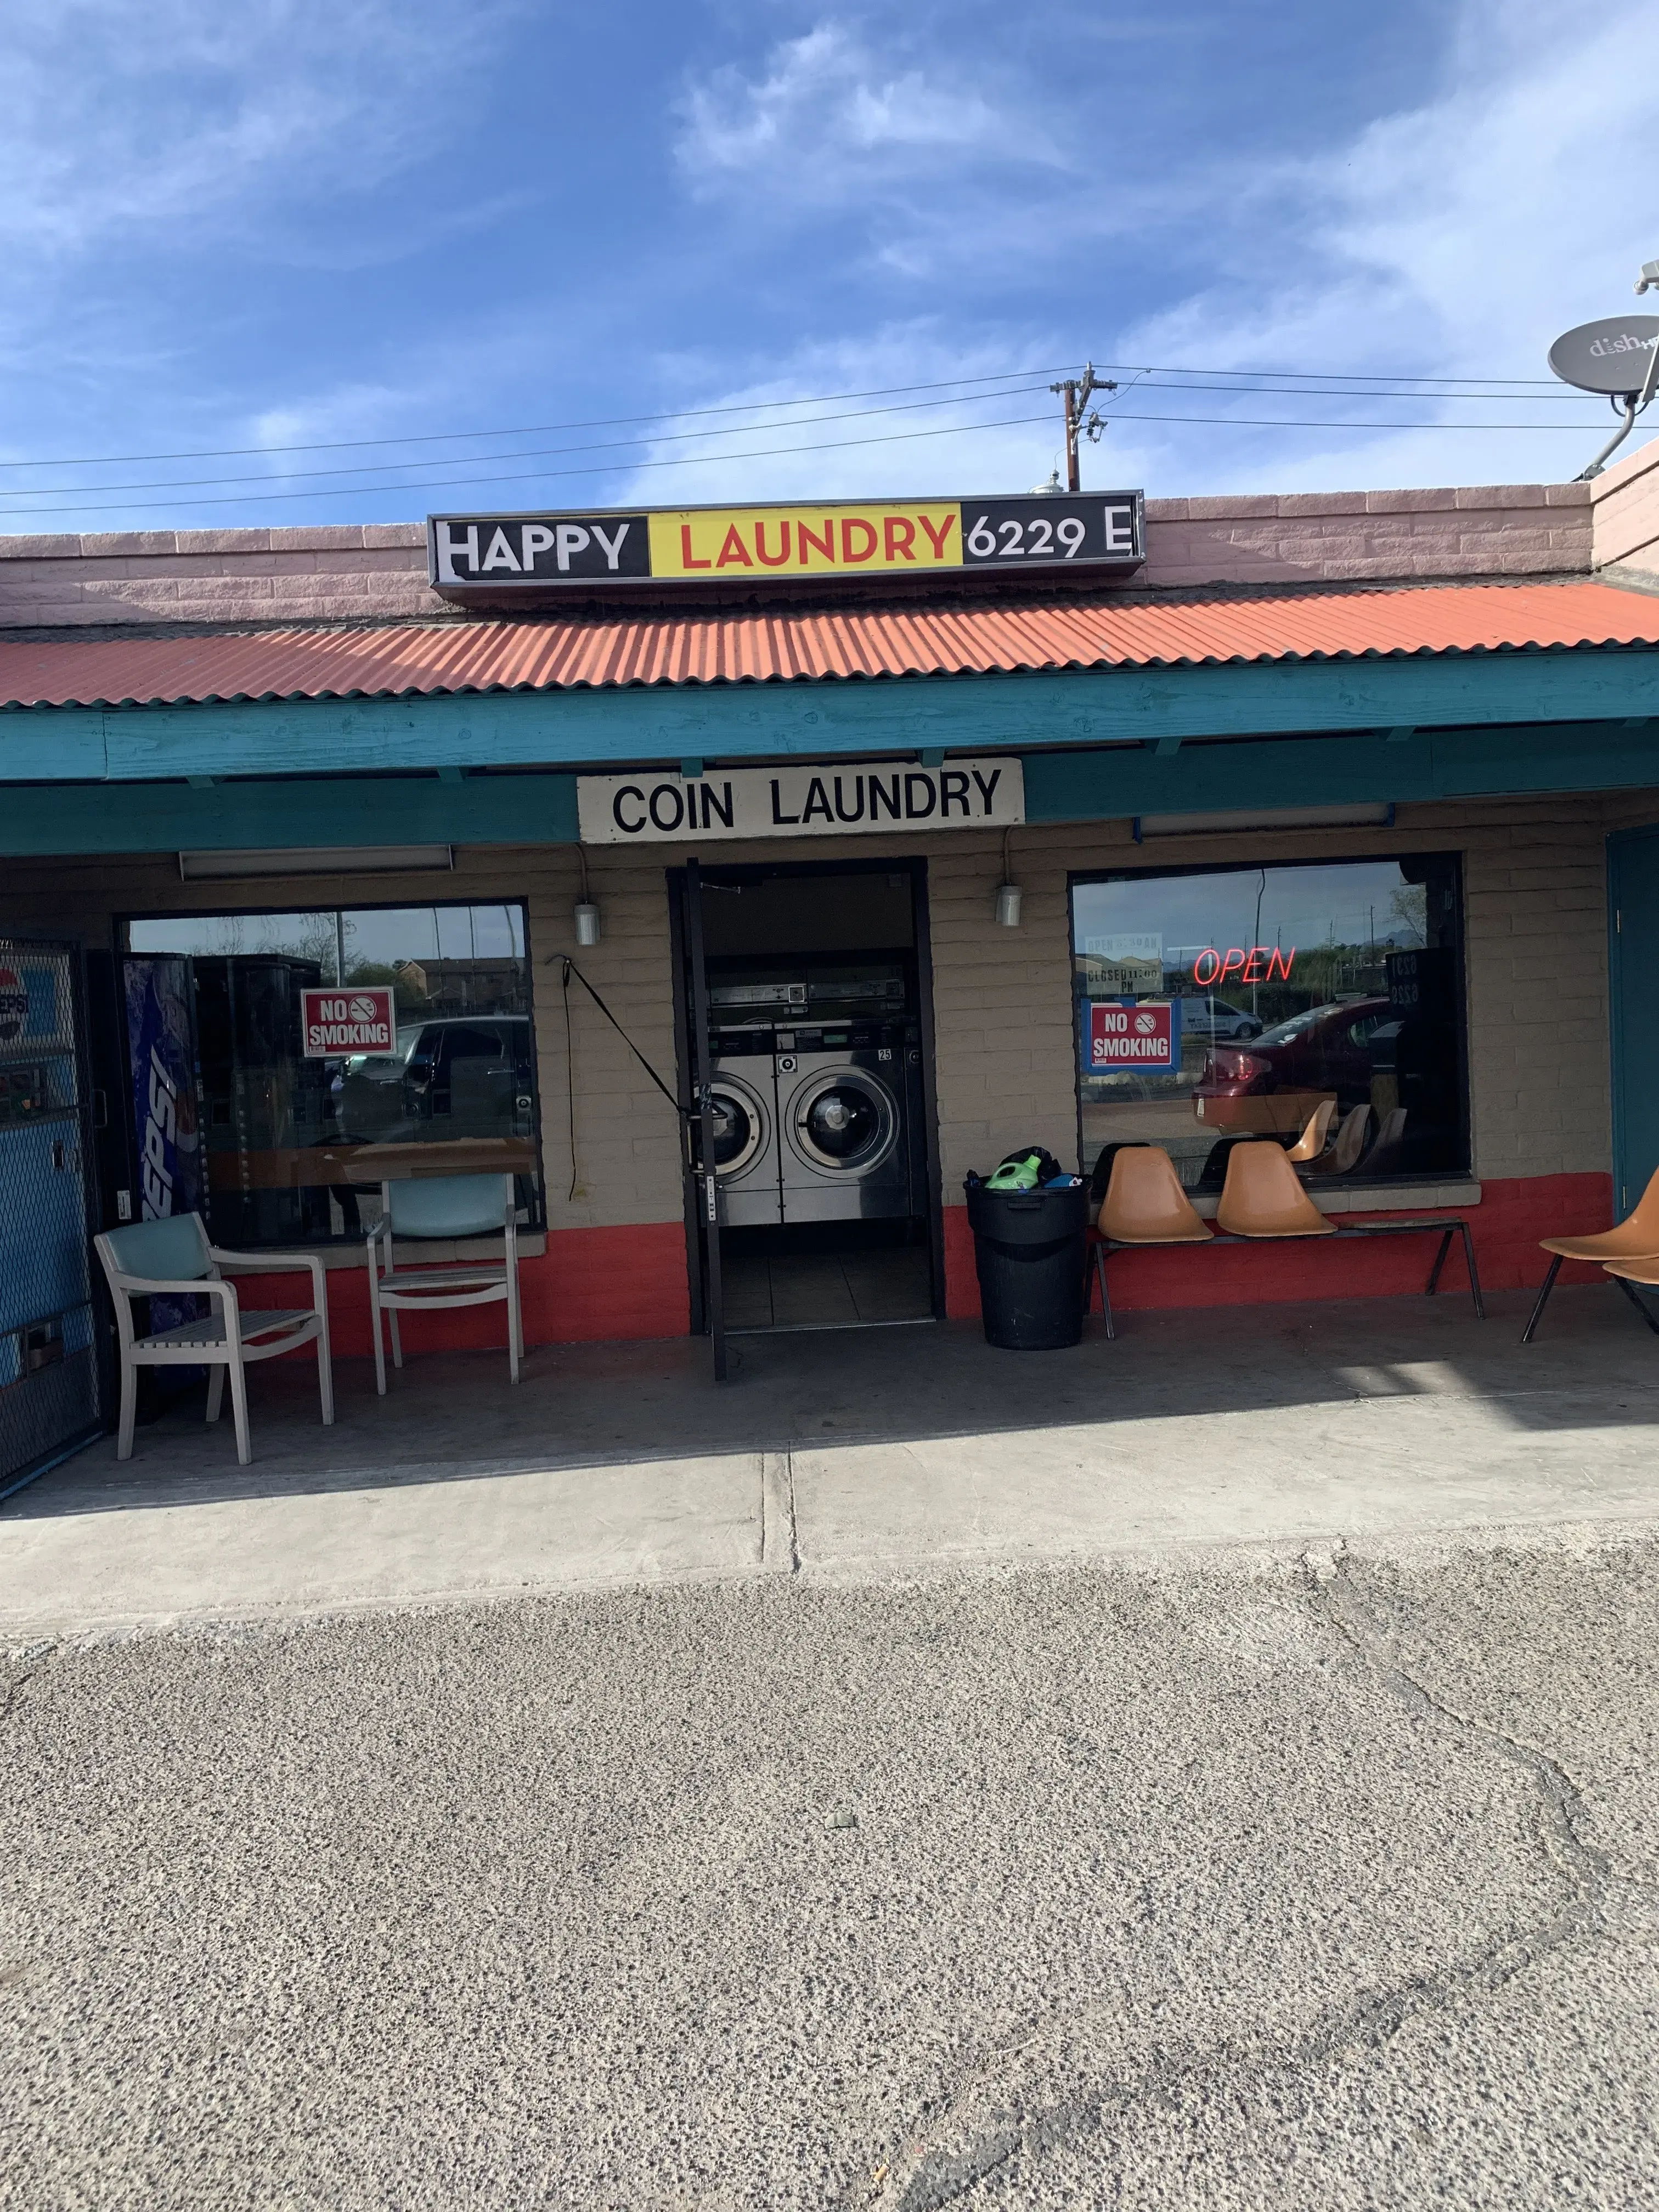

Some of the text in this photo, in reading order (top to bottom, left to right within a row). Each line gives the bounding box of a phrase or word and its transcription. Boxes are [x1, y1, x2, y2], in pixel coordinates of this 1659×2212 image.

[1589, 333, 1643, 357] dish
[437, 506, 1131, 580] HAPPY LAUNDRY 6229 E
[612, 769, 1002, 833] COIN LAUNDRY
[1088, 938, 1113, 952] OPEN
[1088, 969, 1157, 982] CLOSED 11:00
[1194, 946, 1296, 985] OPEN
[320, 999, 348, 1022] NO
[1105, 1013, 1128, 1032] NO
[309, 1023, 388, 1045] SMOKING
[880, 1050, 890, 1059] 25
[1093, 1037, 1168, 1057] SMOKING
